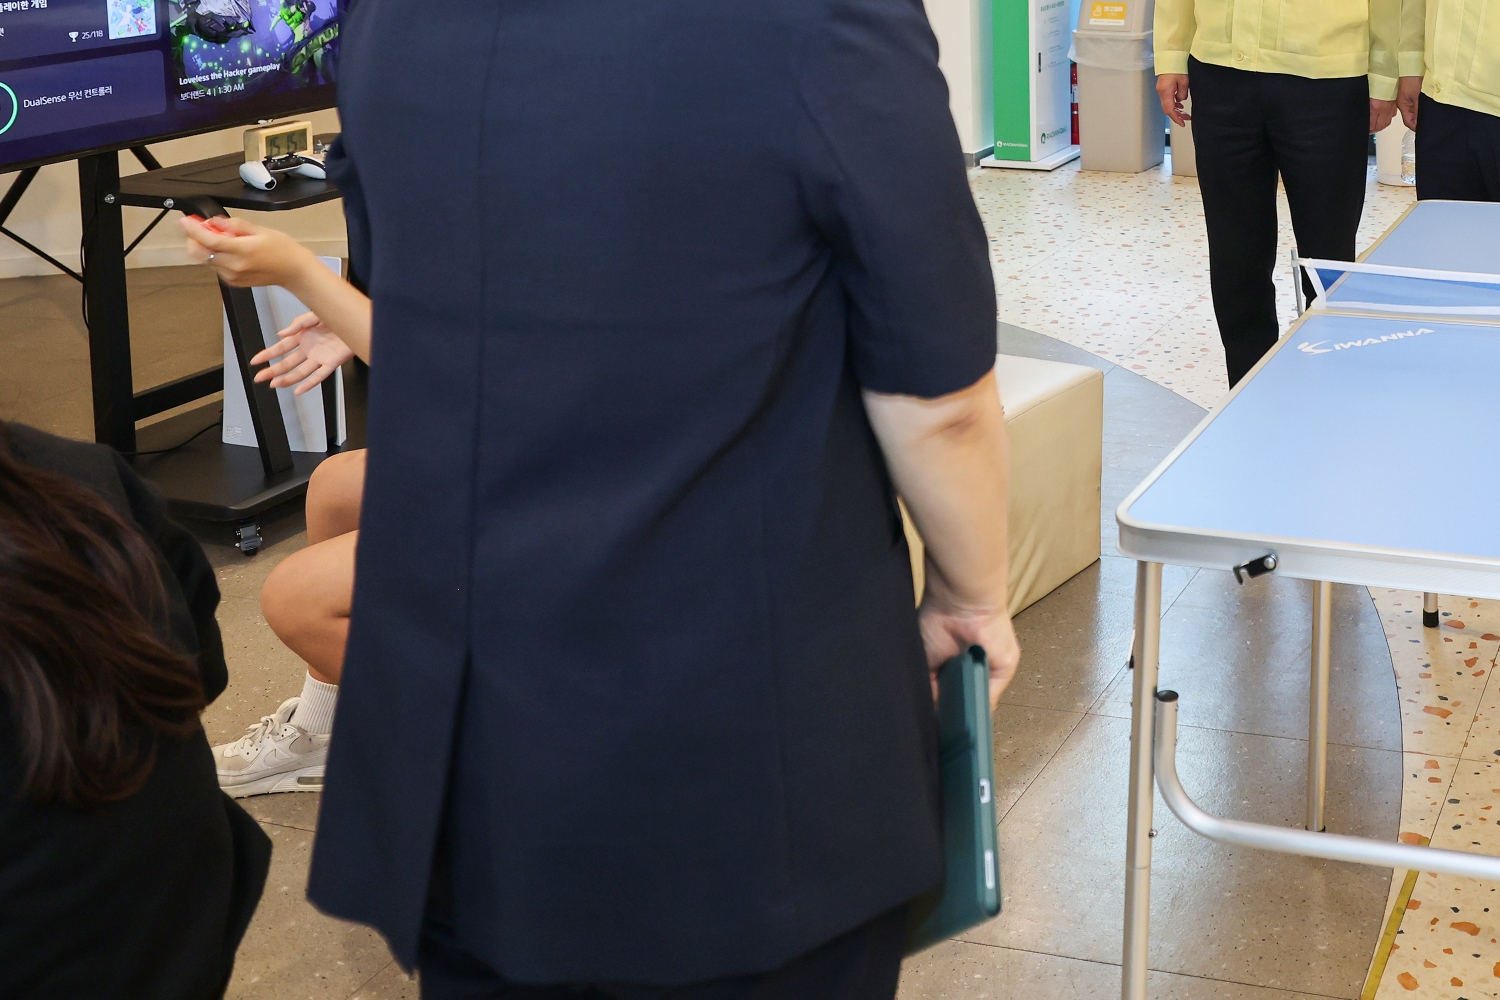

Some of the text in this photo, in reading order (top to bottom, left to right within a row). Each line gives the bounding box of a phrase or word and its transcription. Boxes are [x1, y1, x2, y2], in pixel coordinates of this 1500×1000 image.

[81, 30, 104, 40] 25/118
[179, 62, 281, 86] Loveless the Hacker gameplay
[23, 94, 67, 108] DualSense
[84, 86, 113, 98] 컨트롤러
[206, 88, 212, 96] 4
[232, 83, 245, 92] AM
